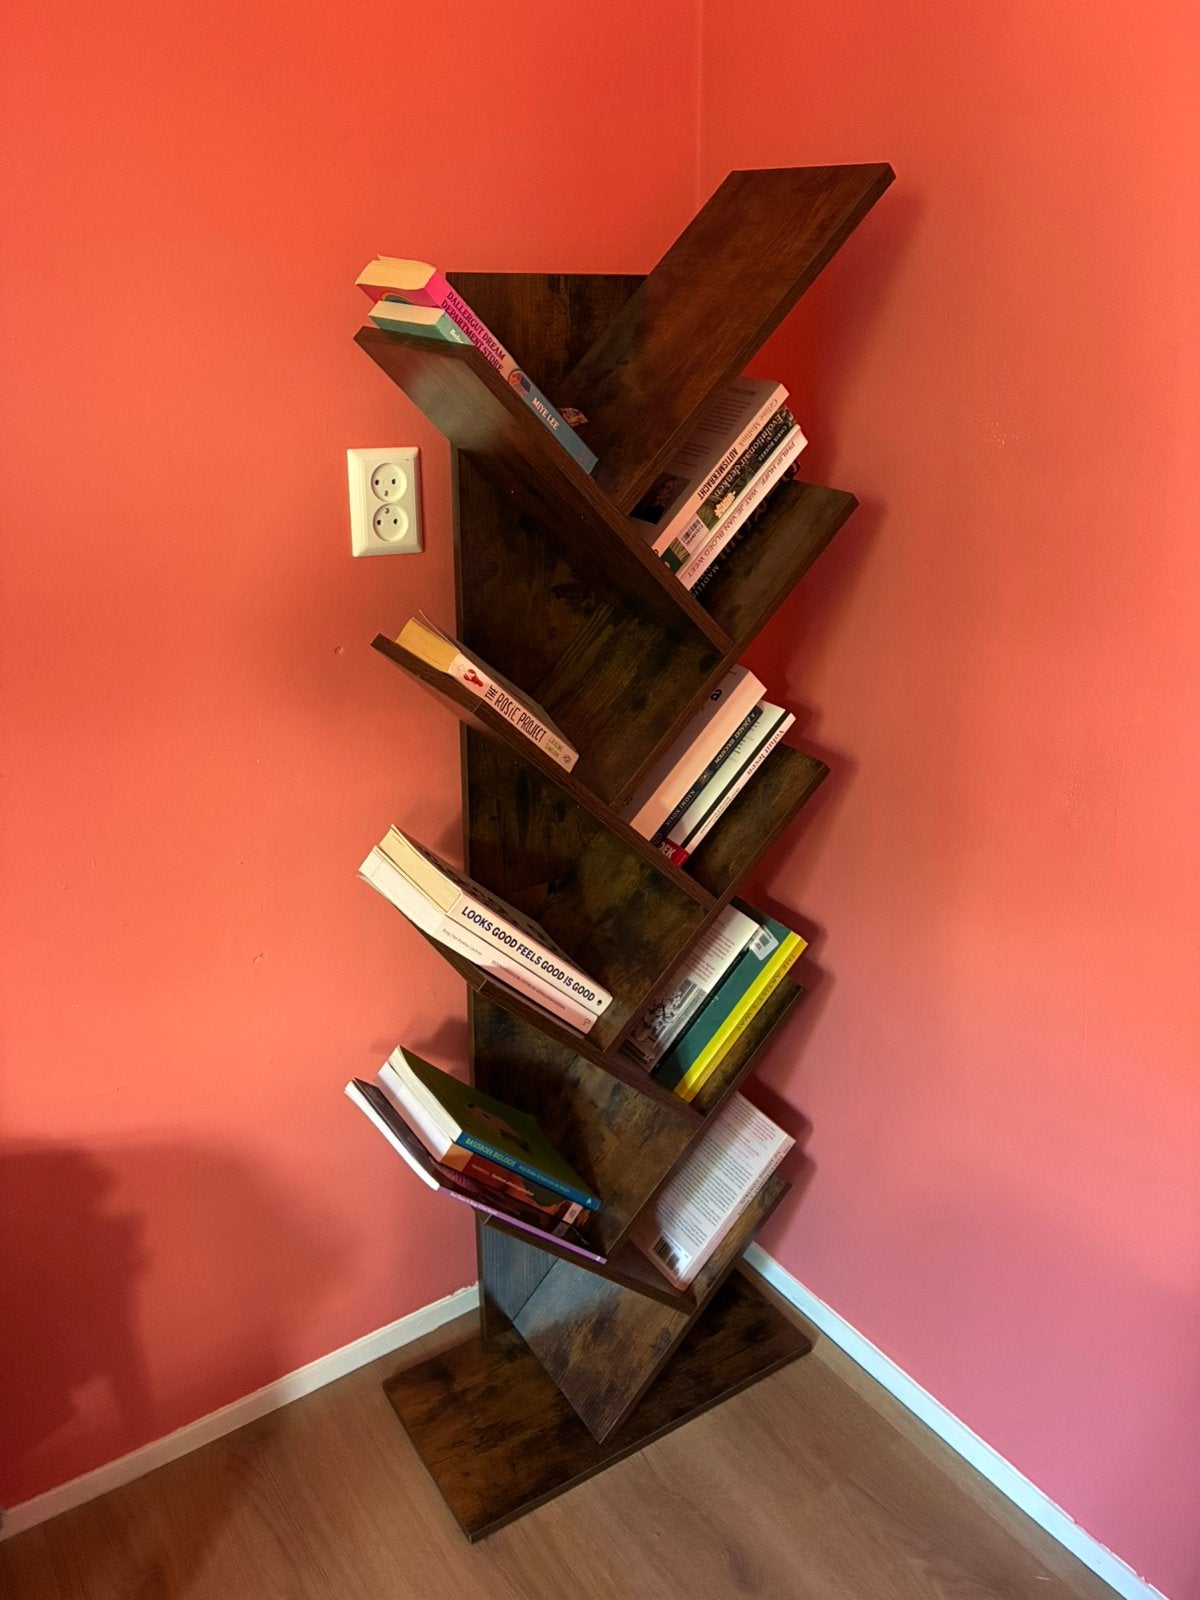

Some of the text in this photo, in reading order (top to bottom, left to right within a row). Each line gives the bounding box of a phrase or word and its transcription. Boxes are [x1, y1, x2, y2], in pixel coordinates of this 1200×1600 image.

[441, 300, 504, 373] DEPARTMENT STORE
[447, 291, 506, 361] DALLERGUT DREAM
[532, 397, 560, 430] MIYE LEE
[738, 412, 783, 467] Evolutionair
[772, 424, 787, 442] CHRIS
[775, 441, 795, 466] PHILIP
[696, 447, 740, 500] AUTISMEKRACHT
[713, 463, 743, 497] denken
[759, 463, 777, 486] HUFF
[736, 503, 745, 516] JE
[742, 488, 758, 507] WAT
[722, 514, 738, 531] VAN
[703, 529, 724, 557] BLOED
[685, 554, 705, 578] WEET
[484, 684, 498, 701] THE
[517, 711, 548, 743] PROJECT
[733, 716, 753, 739] DEADLY
[713, 737, 736, 764] EDUCATION
[763, 729, 785, 753] Voluit
[745, 752, 765, 775] leven
[677, 789, 696, 810] NAOMI
[461, 906, 493, 932] LOOKS
[491, 926, 518, 949] GOOD
[516, 944, 543, 965] FEELS
[540, 960, 565, 981] GOOD
[563, 975, 574, 987] IS
[571, 980, 595, 1002] GOOD
[781, 952, 796, 970] THE
[736, 1010, 753, 1031] WAY
[465, 1137, 495, 1158] BASISBOEK
